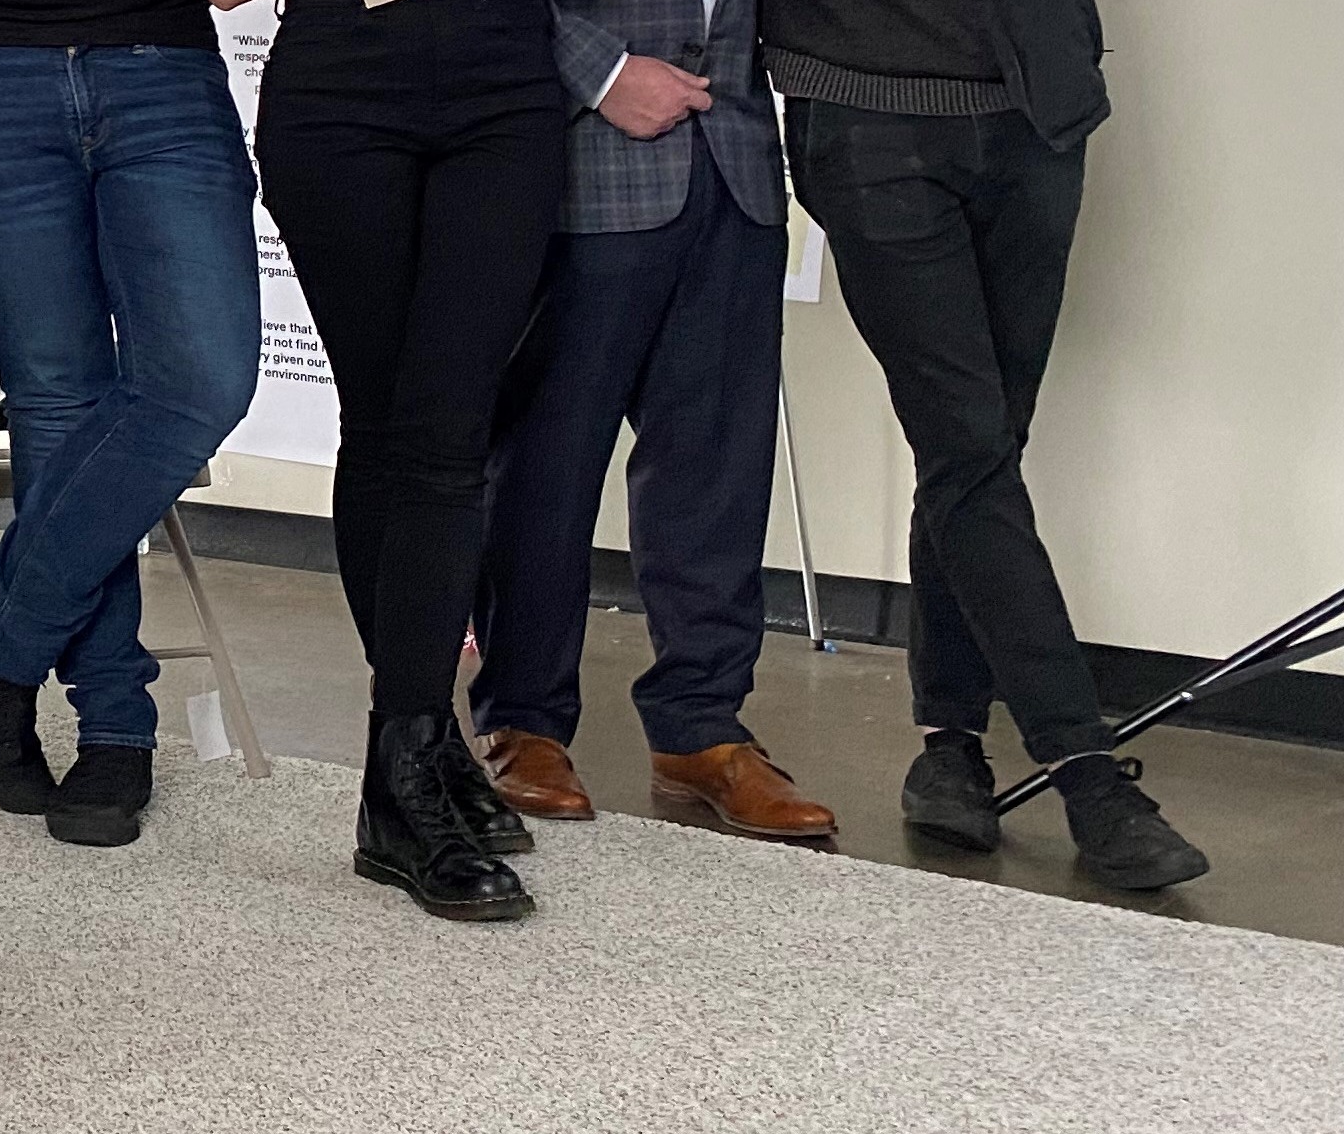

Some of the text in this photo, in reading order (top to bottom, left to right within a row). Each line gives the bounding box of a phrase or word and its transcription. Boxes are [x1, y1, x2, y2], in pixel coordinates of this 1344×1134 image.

[258, 234, 284, 247] resp
[263, 318, 313, 335] ieve that
[274, 338, 293, 349] not
[295, 338, 318, 352] find
[272, 352, 304, 365] given
[306, 357, 327, 368] our
[264, 368, 333, 385] environmen
